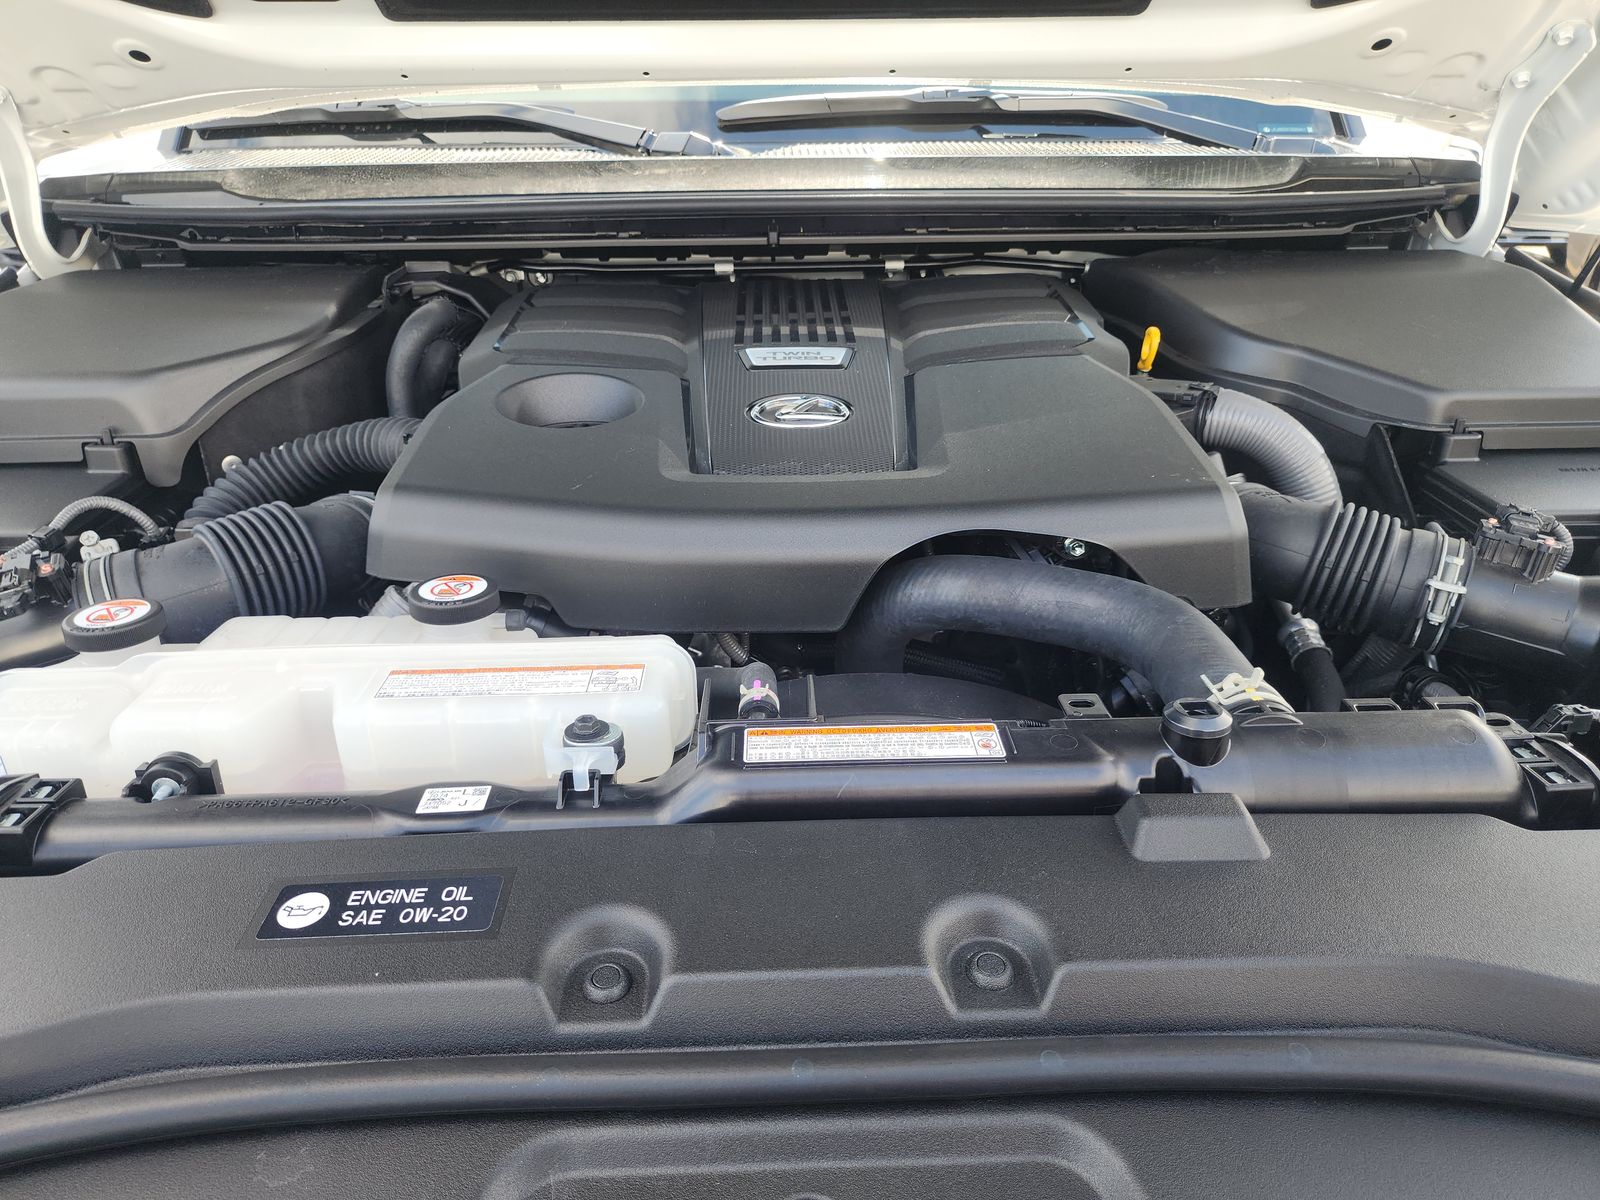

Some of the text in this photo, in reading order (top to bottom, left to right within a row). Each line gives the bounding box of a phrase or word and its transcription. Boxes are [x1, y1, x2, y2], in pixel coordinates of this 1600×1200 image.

[346, 886, 473, 906] ENGINE OIL
[338, 905, 468, 926] SAE 0W-20
